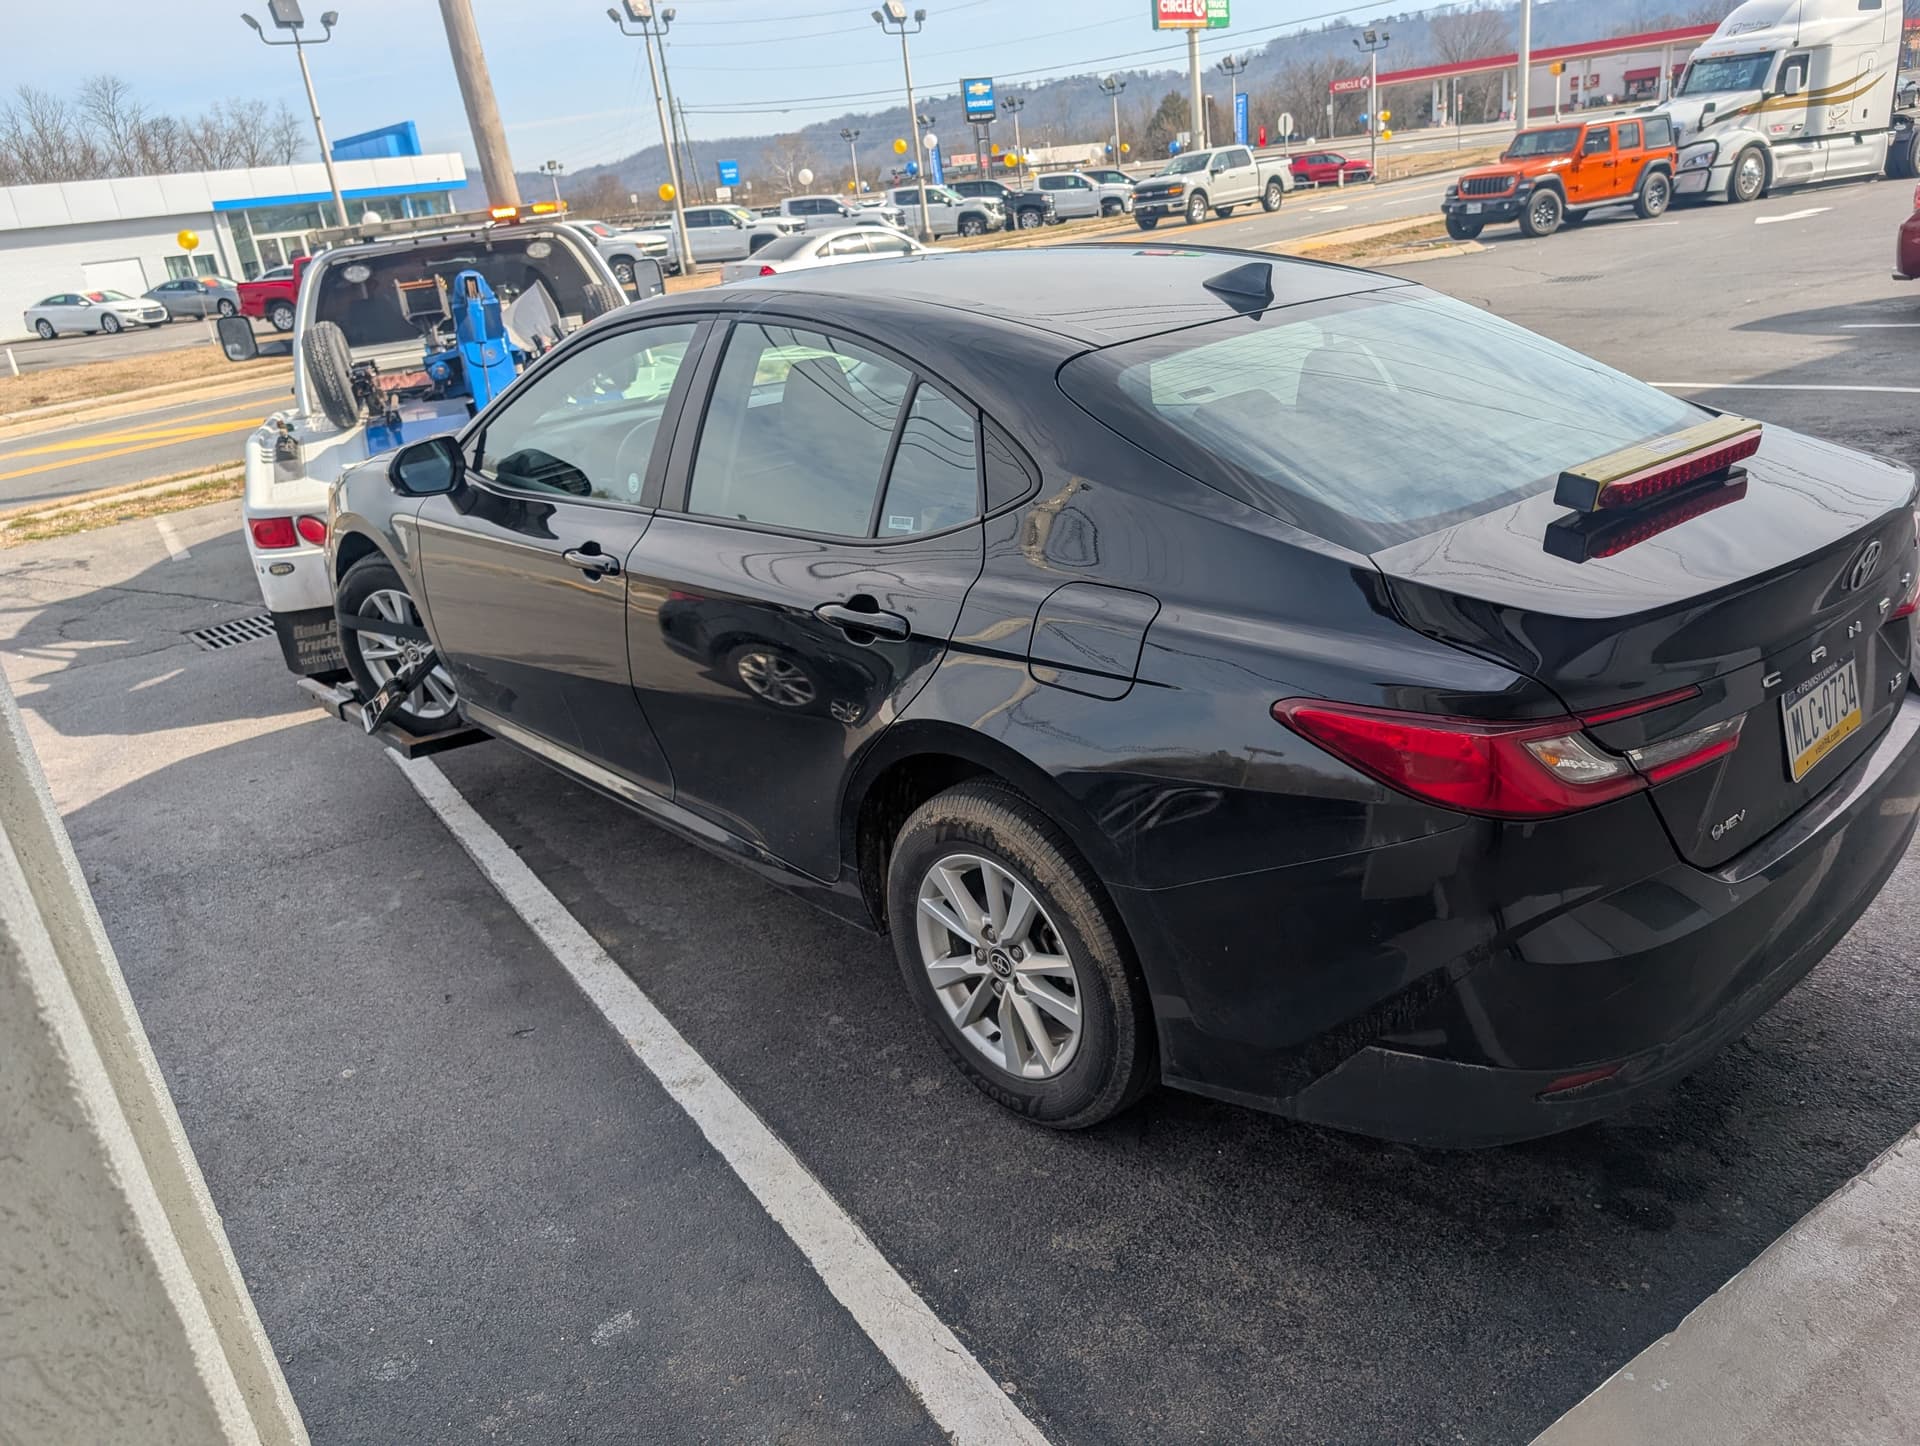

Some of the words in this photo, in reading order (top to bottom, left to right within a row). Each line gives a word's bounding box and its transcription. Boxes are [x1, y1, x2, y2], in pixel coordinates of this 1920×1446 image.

[1160, 0, 1193, 13] CIRCLE
[1335, 80, 1359, 90] CIRCLE
[1800, 662, 1838, 694] PENNSYLVANIA
